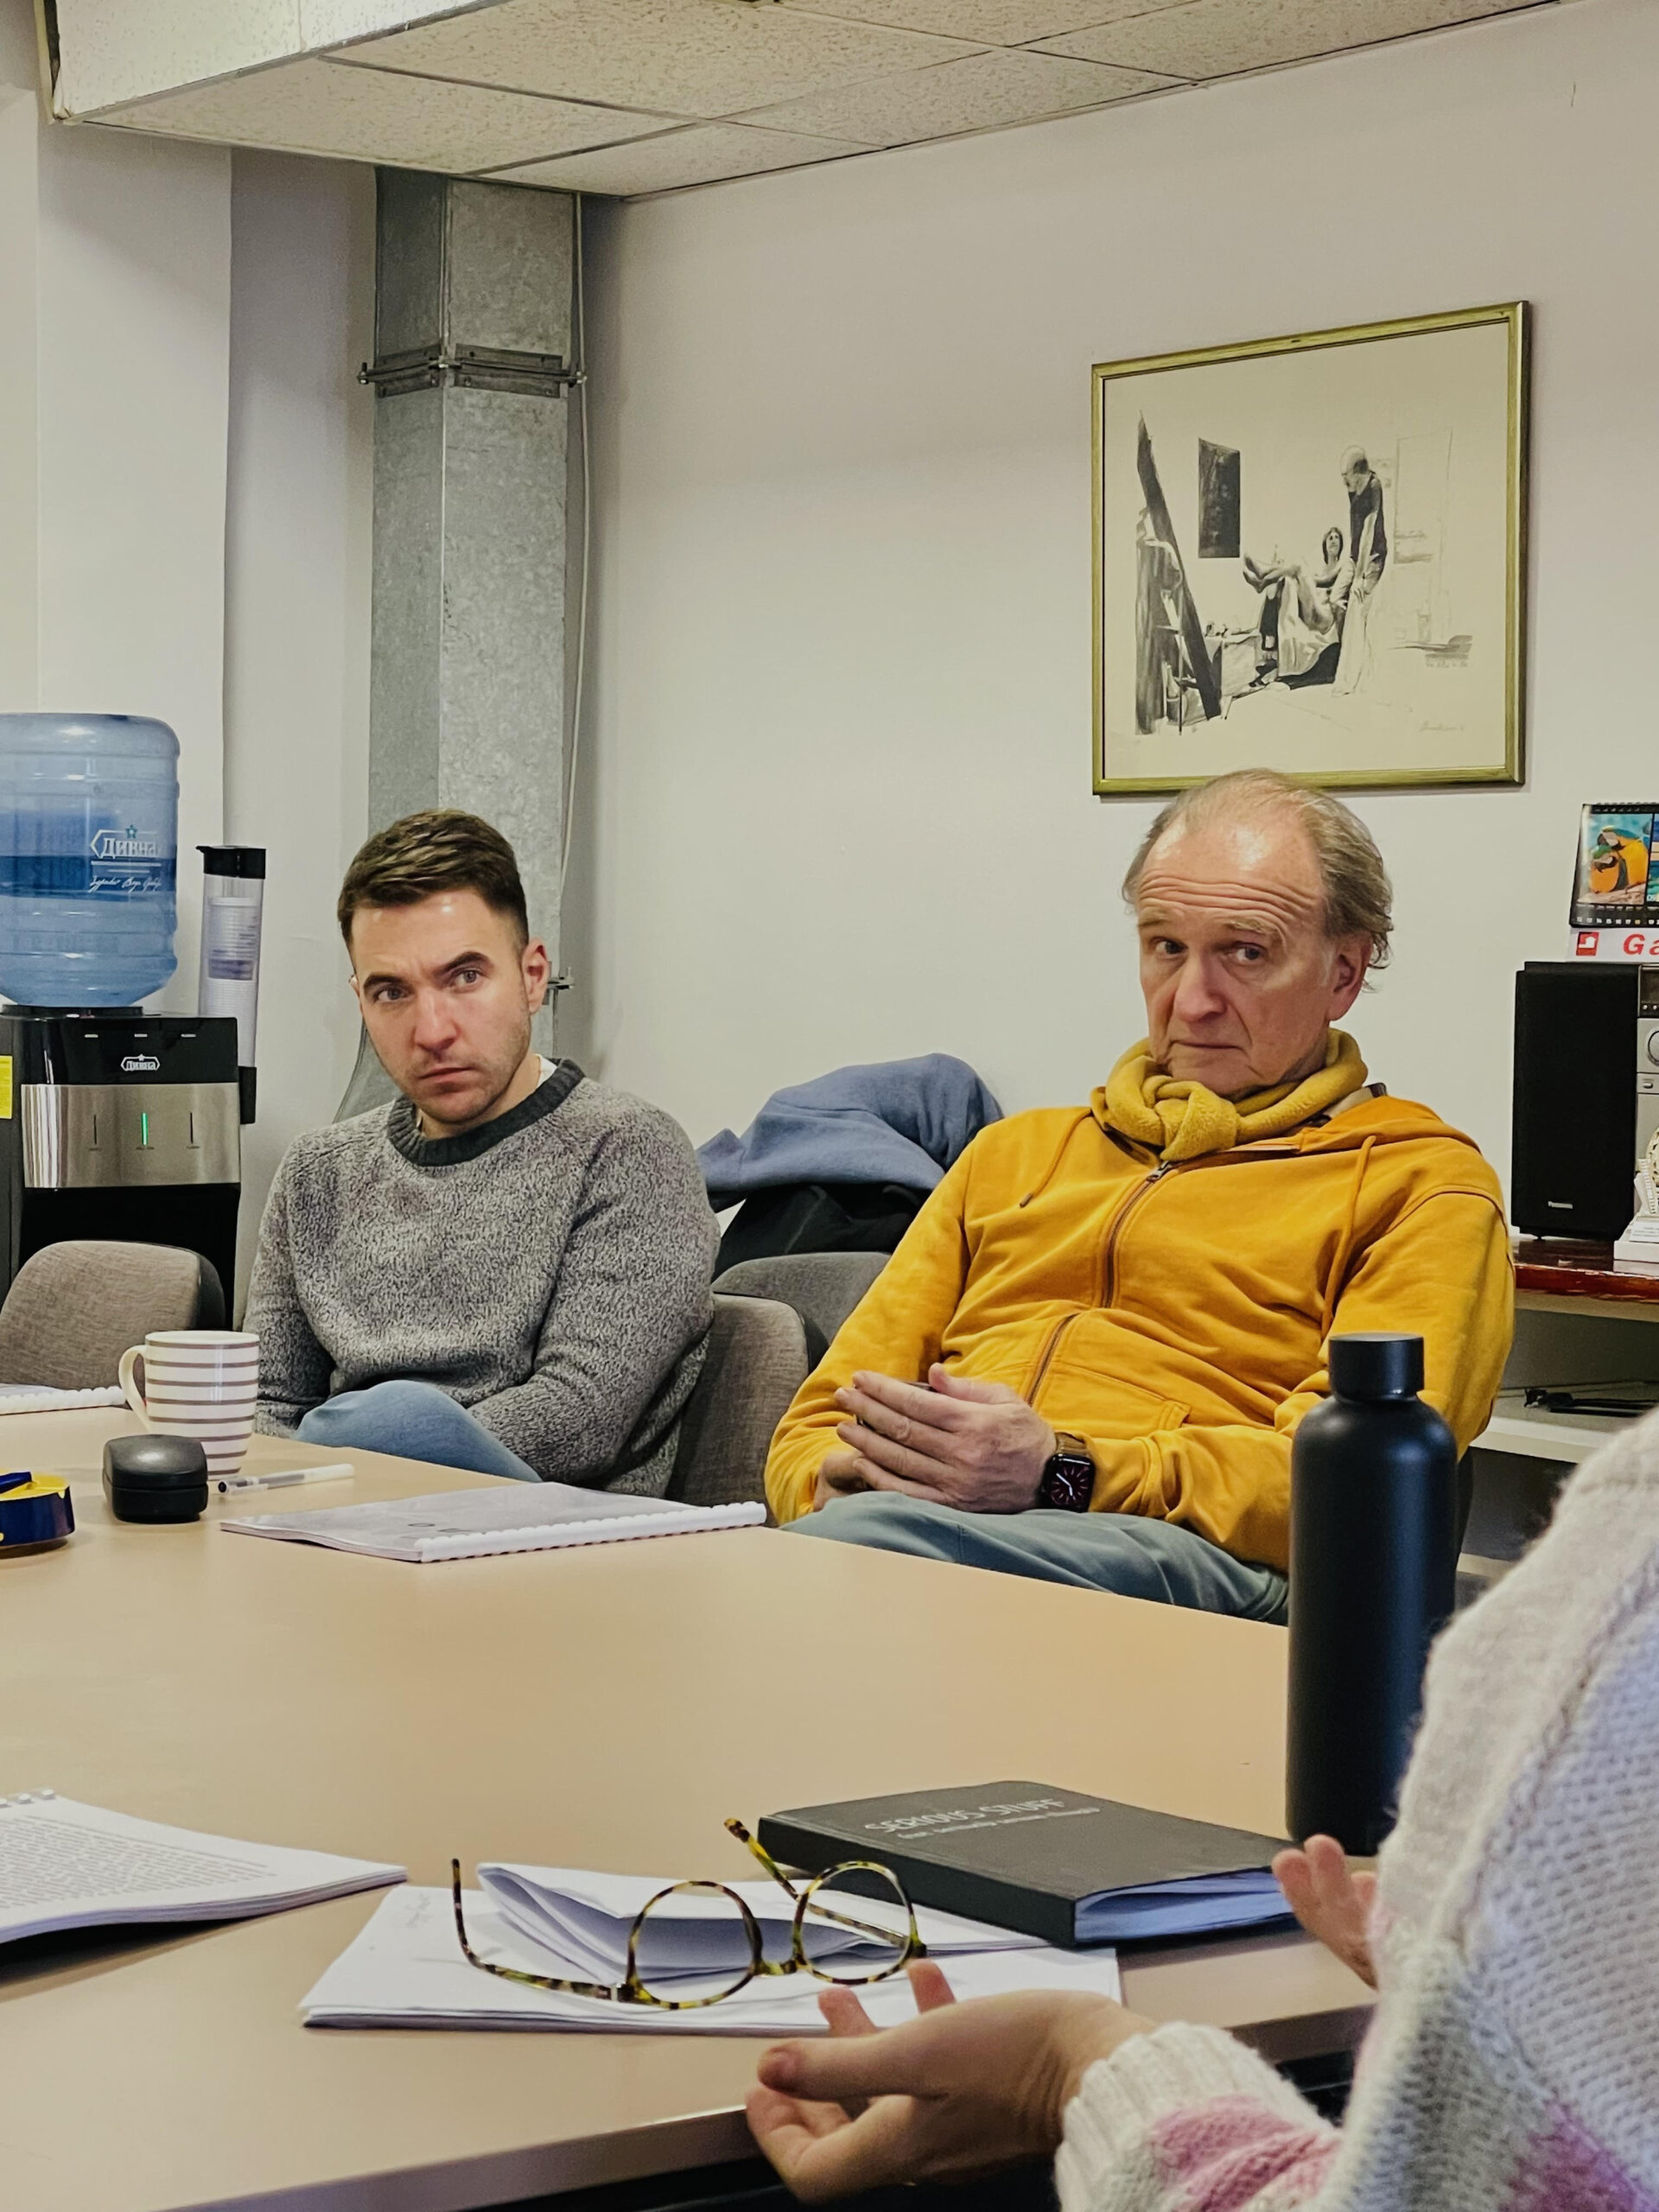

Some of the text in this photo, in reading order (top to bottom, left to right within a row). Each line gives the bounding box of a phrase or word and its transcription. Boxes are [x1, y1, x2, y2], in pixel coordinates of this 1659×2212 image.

[99, 837, 160, 859] Дивна
[864, 1809, 985, 1833] SERIOUS
[978, 1798, 1065, 1815] STUFF
